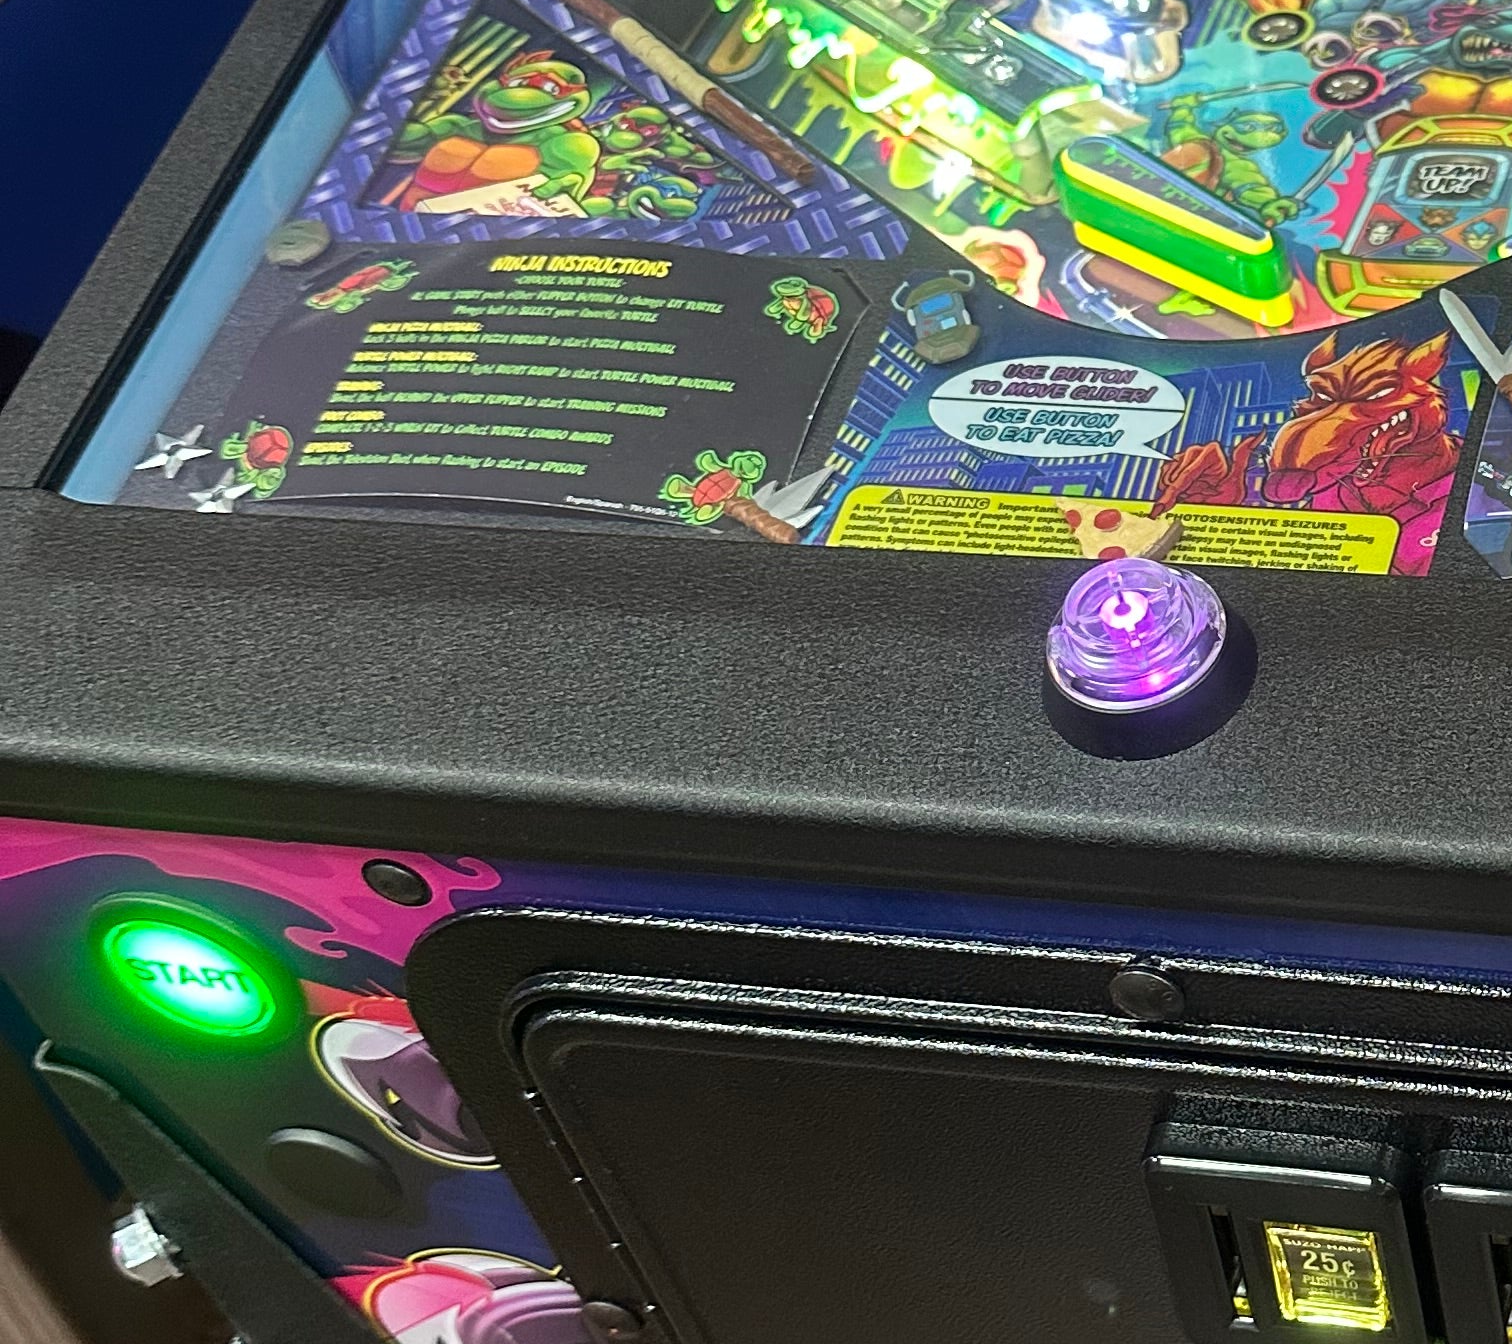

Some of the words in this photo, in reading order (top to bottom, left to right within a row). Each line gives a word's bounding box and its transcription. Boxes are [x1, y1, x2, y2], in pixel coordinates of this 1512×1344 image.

[1420, 165, 1488, 178] TEAM
[1424, 177, 1474, 193] UP!
[491, 256, 544, 272] NINJA
[547, 257, 672, 277] INSTRUCTIONS
[1003, 363, 1050, 380] USE
[1051, 365, 1139, 384] BUTTON
[969, 379, 1001, 395] TO
[1002, 382, 1069, 399] MOVE
[1070, 386, 1159, 403] GLIDER!
[984, 407, 1029, 424] USE
[1031, 410, 1120, 429] BUTTON
[965, 423, 996, 440] TO
[998, 425, 1046, 443] EAT
[1044, 429, 1125, 447] PIZZA!
[863, 505, 883, 515] very
[912, 507, 967, 519] percentage
[980, 512, 1013, 522] people
[908, 495, 989, 509] WARNING
[998, 503, 1059, 513] Important
[974, 520, 996, 529] Even
[1166, 512, 1279, 527] PHOTOSENSITIVE
[1281, 520, 1347, 531] SEIZURES
[125, 958, 249, 993] START
[1300, 1250, 1356, 1277] 25¢
[1303, 1275, 1337, 1287] PUSH
